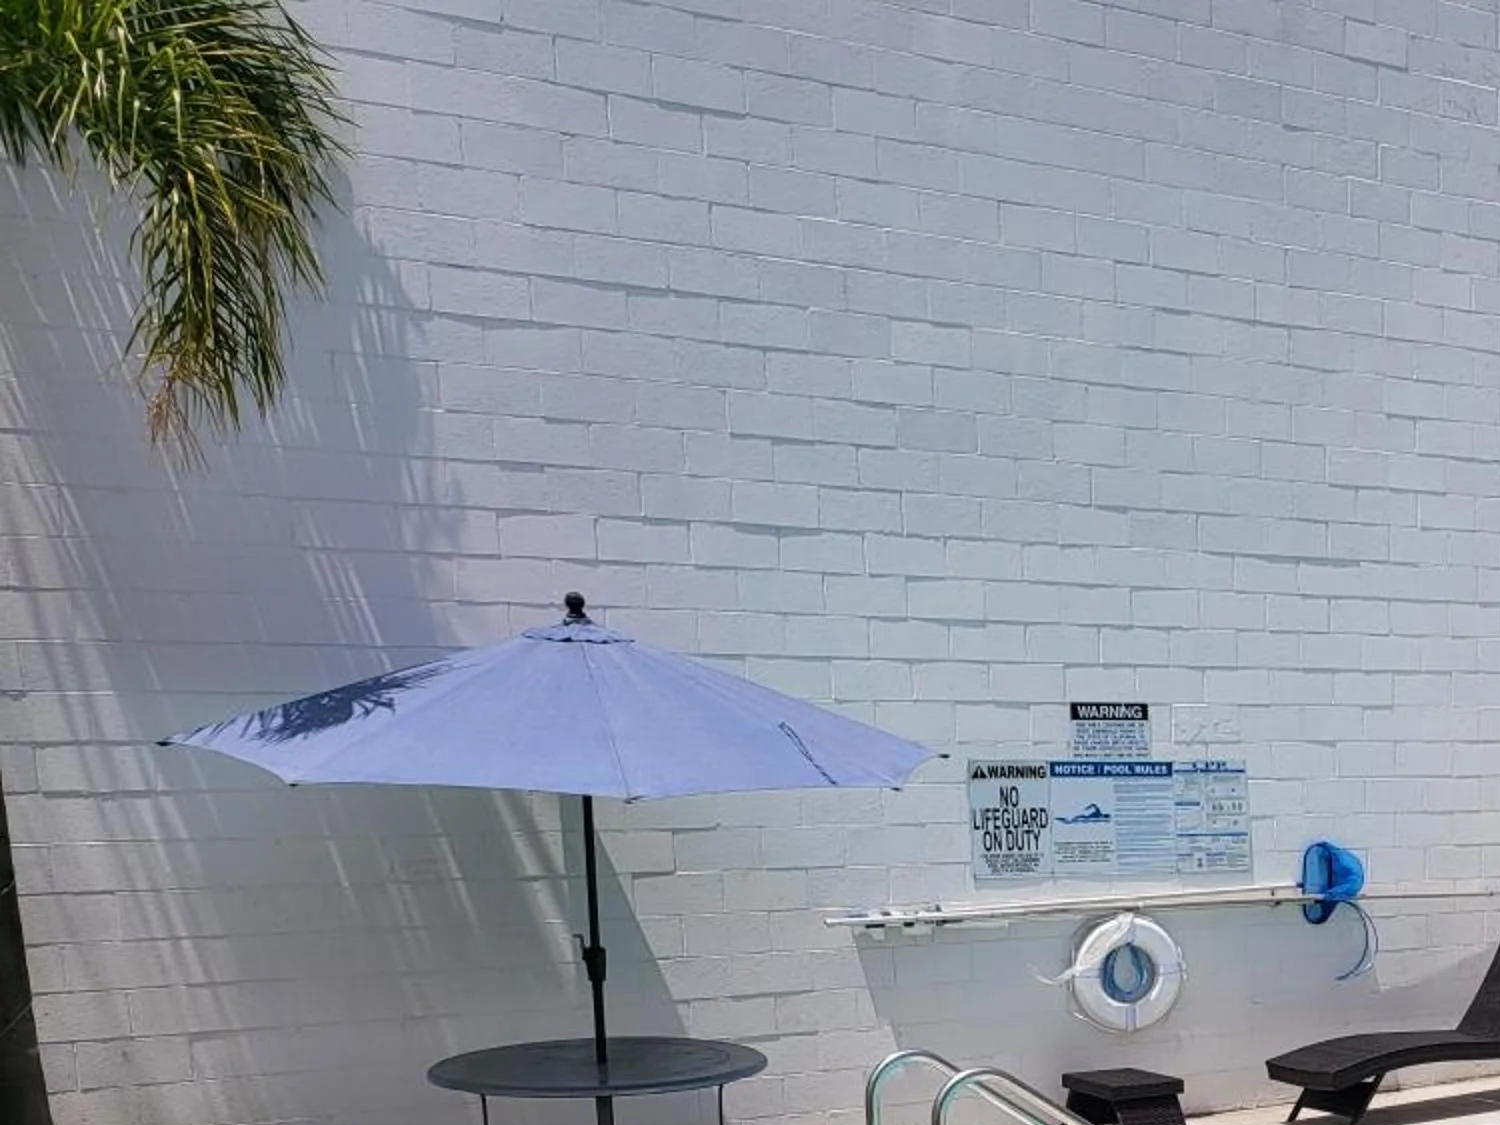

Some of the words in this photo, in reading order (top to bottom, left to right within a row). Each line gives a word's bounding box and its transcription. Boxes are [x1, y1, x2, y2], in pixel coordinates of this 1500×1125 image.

[1077, 704, 1143, 719] WARNING
[987, 765, 1047, 779] WARNING
[1054, 764, 1095, 775] NOTICE
[1103, 764, 1132, 775] POOL
[1134, 764, 1169, 775] RULES
[999, 785, 1020, 808] NO
[973, 807, 1049, 831] LIFEGUARD
[983, 831, 1003, 852] ON
[1005, 829, 1041, 851] DUTY
